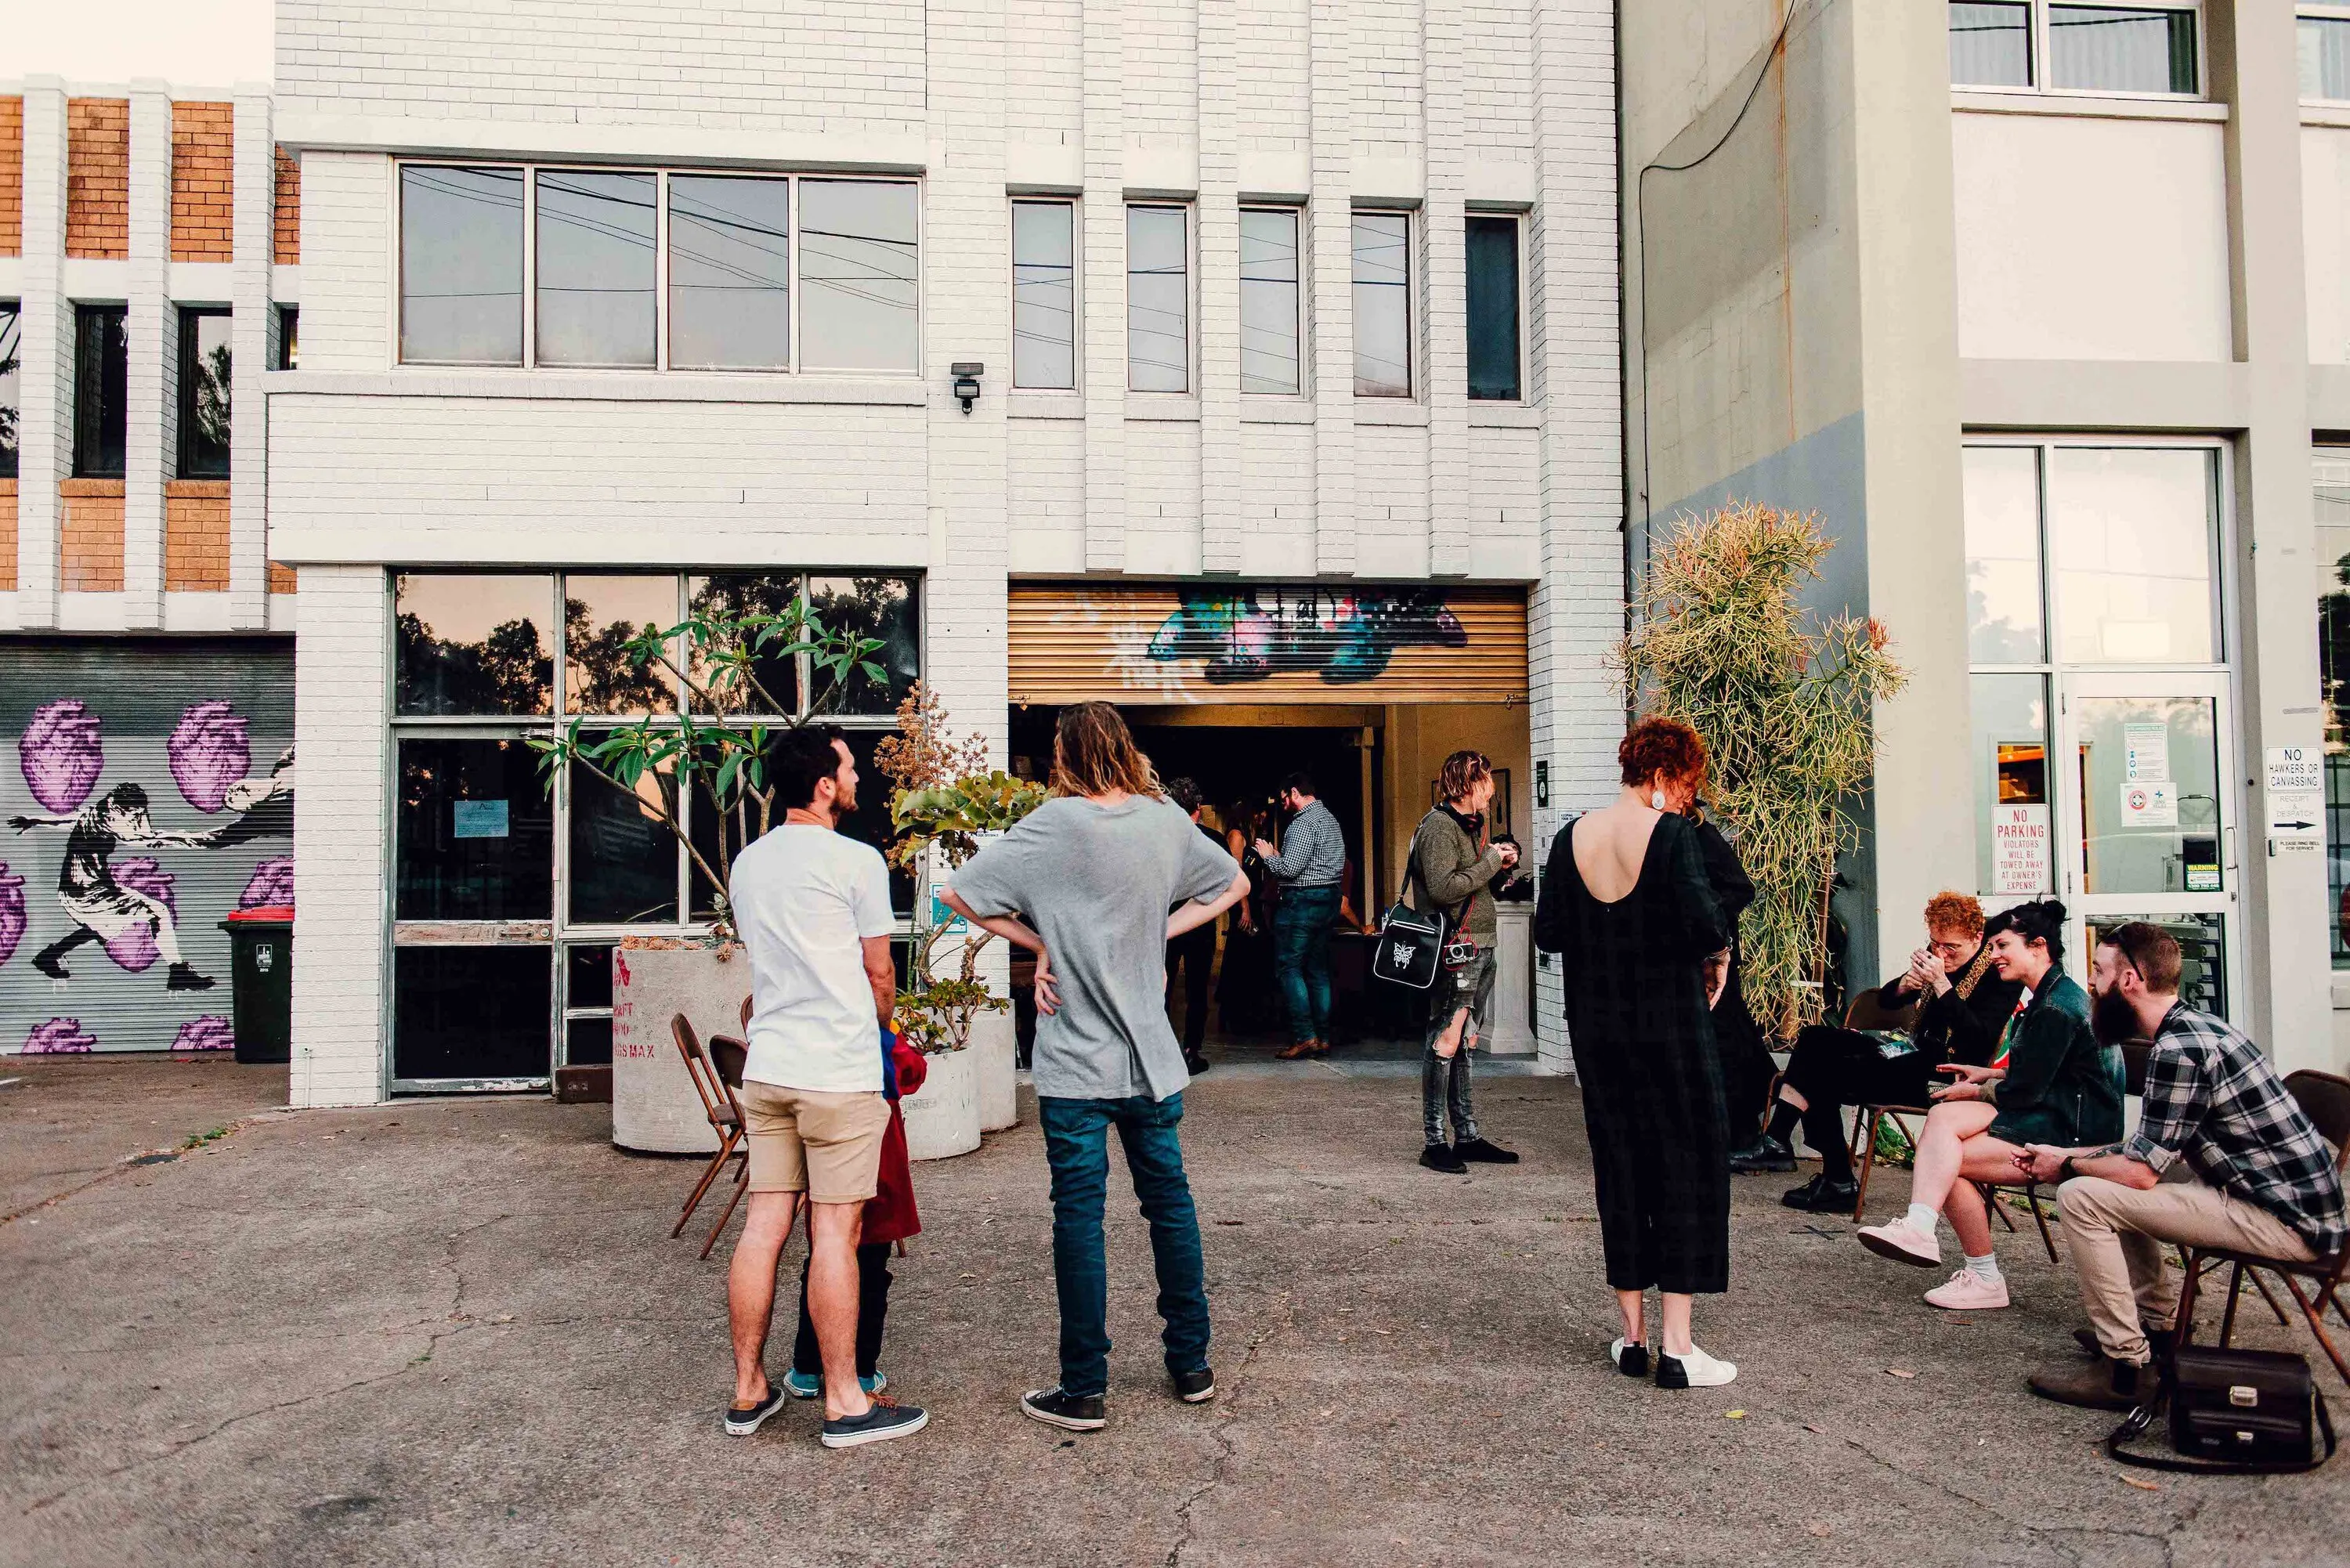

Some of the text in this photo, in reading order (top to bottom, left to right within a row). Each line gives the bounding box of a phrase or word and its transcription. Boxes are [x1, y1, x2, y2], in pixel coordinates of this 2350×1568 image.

[2284, 749, 2301, 761] NO
[2269, 764, 2319, 774] HAWKERS OR
[2271, 776, 2317, 786] CANVASSING
[2013, 809, 2027, 822] NO
[1998, 825, 2044, 837] PARKING
[2003, 840, 2039, 848] VIOLATORS
[2012, 870, 2042, 879] OWNER'S
[2007, 881, 2037, 890] EXPENSE
[629, 1044, 655, 1058] MAX
